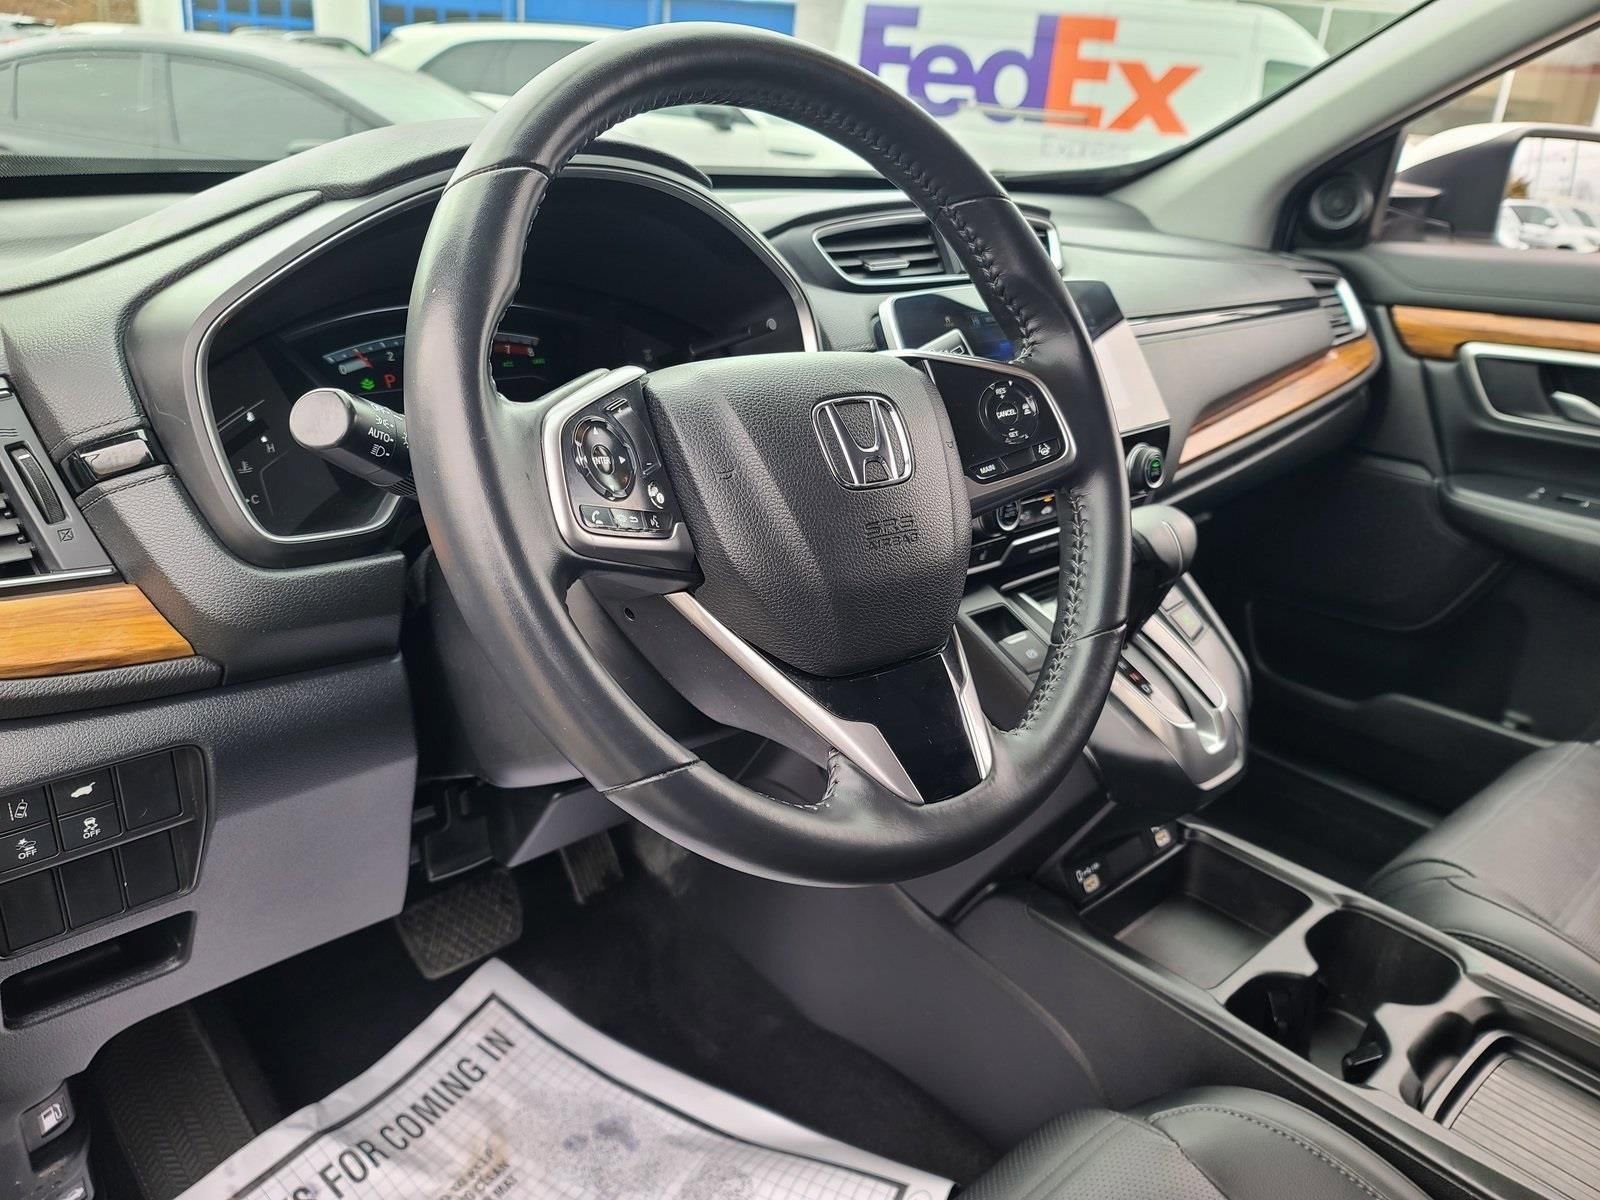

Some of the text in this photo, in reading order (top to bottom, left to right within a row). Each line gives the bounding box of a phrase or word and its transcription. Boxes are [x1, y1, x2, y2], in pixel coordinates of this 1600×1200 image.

[859, 3, 1202, 136] FedEx
[384, 374, 396, 388] P
[995, 408, 1017, 420] CANCEL
[368, 427, 390, 443] AUTO
[980, 464, 996, 474] MAIN
[83, 829, 101, 840] OFF
[18, 846, 38, 860] OFF
[318, 1027, 516, 1199] FOR COMING IN
